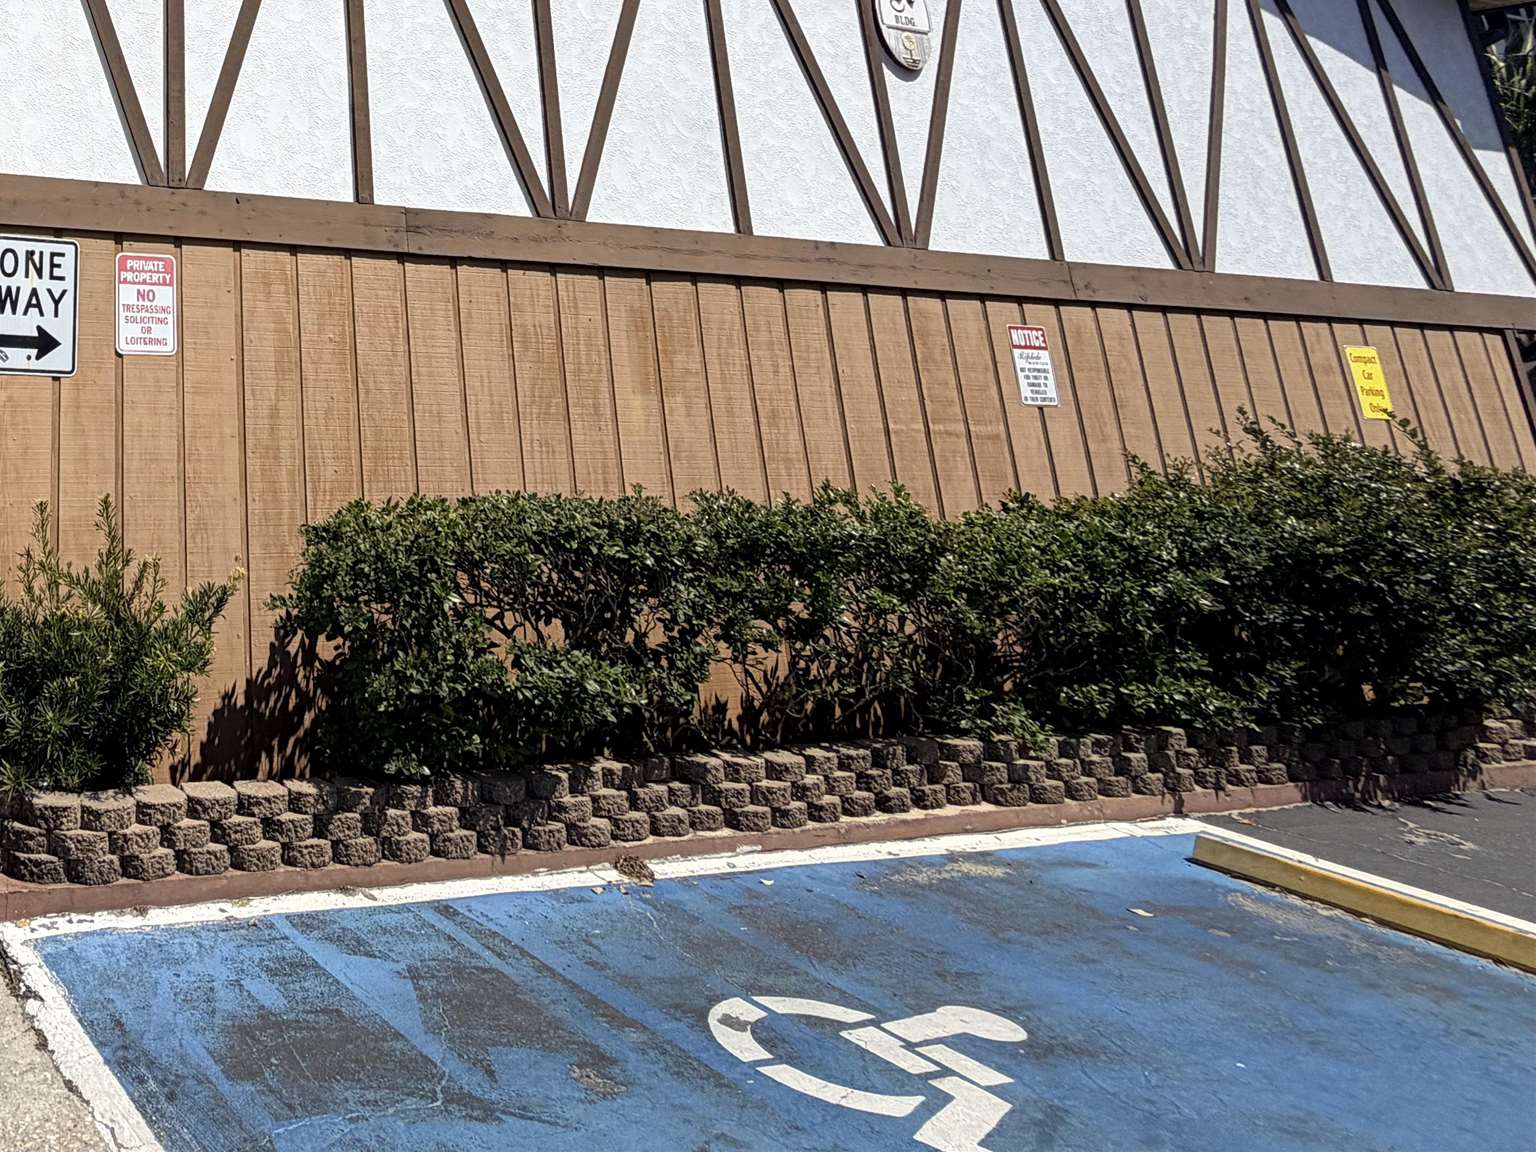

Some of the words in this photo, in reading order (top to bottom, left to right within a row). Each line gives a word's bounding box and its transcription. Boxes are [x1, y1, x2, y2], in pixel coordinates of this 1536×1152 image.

[0, 248, 66, 282] ONE
[126, 259, 165, 272] PRIVATE
[120, 271, 171, 285] PROPERTY
[136, 289, 156, 302] NO
[122, 303, 172, 315] TRESPASSING
[124, 315, 169, 326] SOLICITING
[141, 326, 152, 335] OR
[125, 336, 168, 347] LOITERING
[1010, 329, 1045, 347] NOTICE
[1349, 352, 1378, 365] Compact
[1362, 369, 1374, 380] Car
[1360, 385, 1385, 400] Parking
[1369, 402, 1386, 414] Onl
